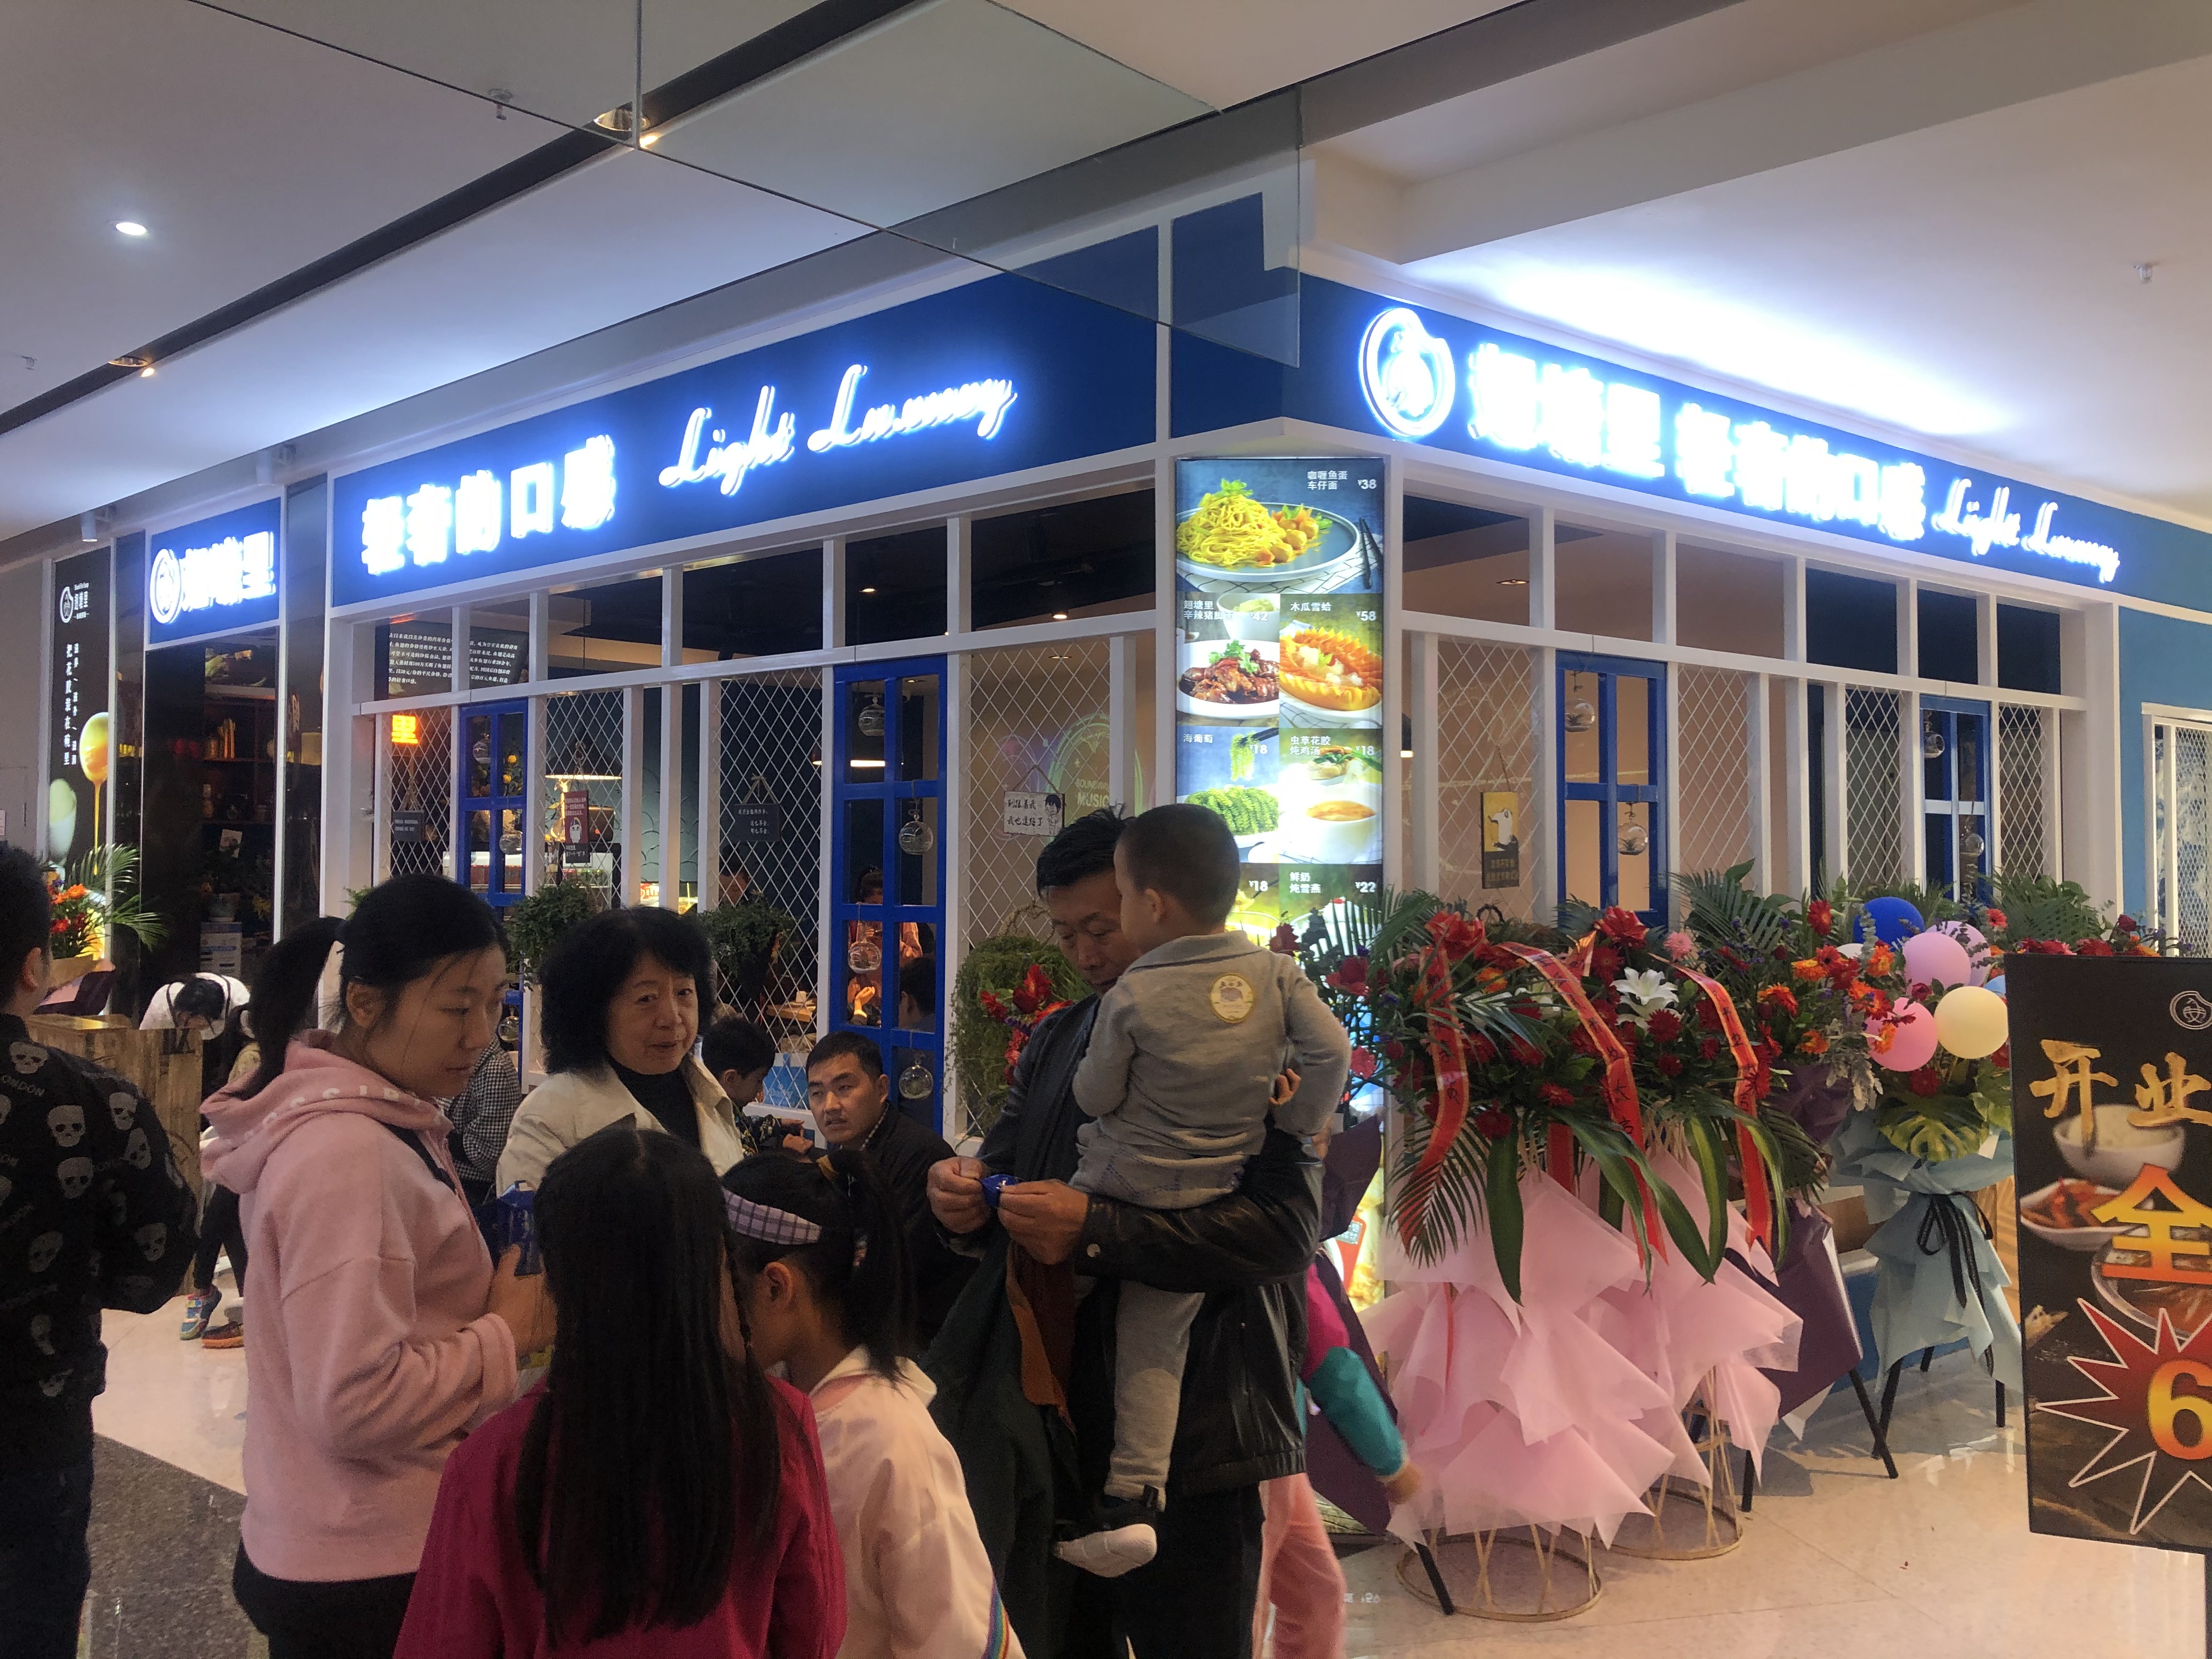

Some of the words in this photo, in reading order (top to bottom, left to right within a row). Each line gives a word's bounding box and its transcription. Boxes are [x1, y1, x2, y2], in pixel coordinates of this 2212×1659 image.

[658, 385, 795, 495] Light
[1307, 470, 1348, 481] 咖喱鱼蛋
[1307, 481, 1338, 490] 车仔面
[1357, 478, 1377, 490] ¥38
[1183, 600, 1214, 610] 翅塘里
[1290, 602, 1331, 612] 木瓜雪蛤
[1356, 610, 1378, 622] ¥58
[1183, 733, 1214, 744] 海葡萄
[1290, 735, 1331, 746] 虫草花胶
[1289, 745, 1321, 756] 炖鸡汤
[1355, 745, 1375, 757] ¥18
[1289, 872, 1311, 883] 鲜奶
[1355, 882, 1376, 894] ¥22
[2029, 1039, 2212, 1160] 开业
[2090, 1163, 2212, 1285] 全
